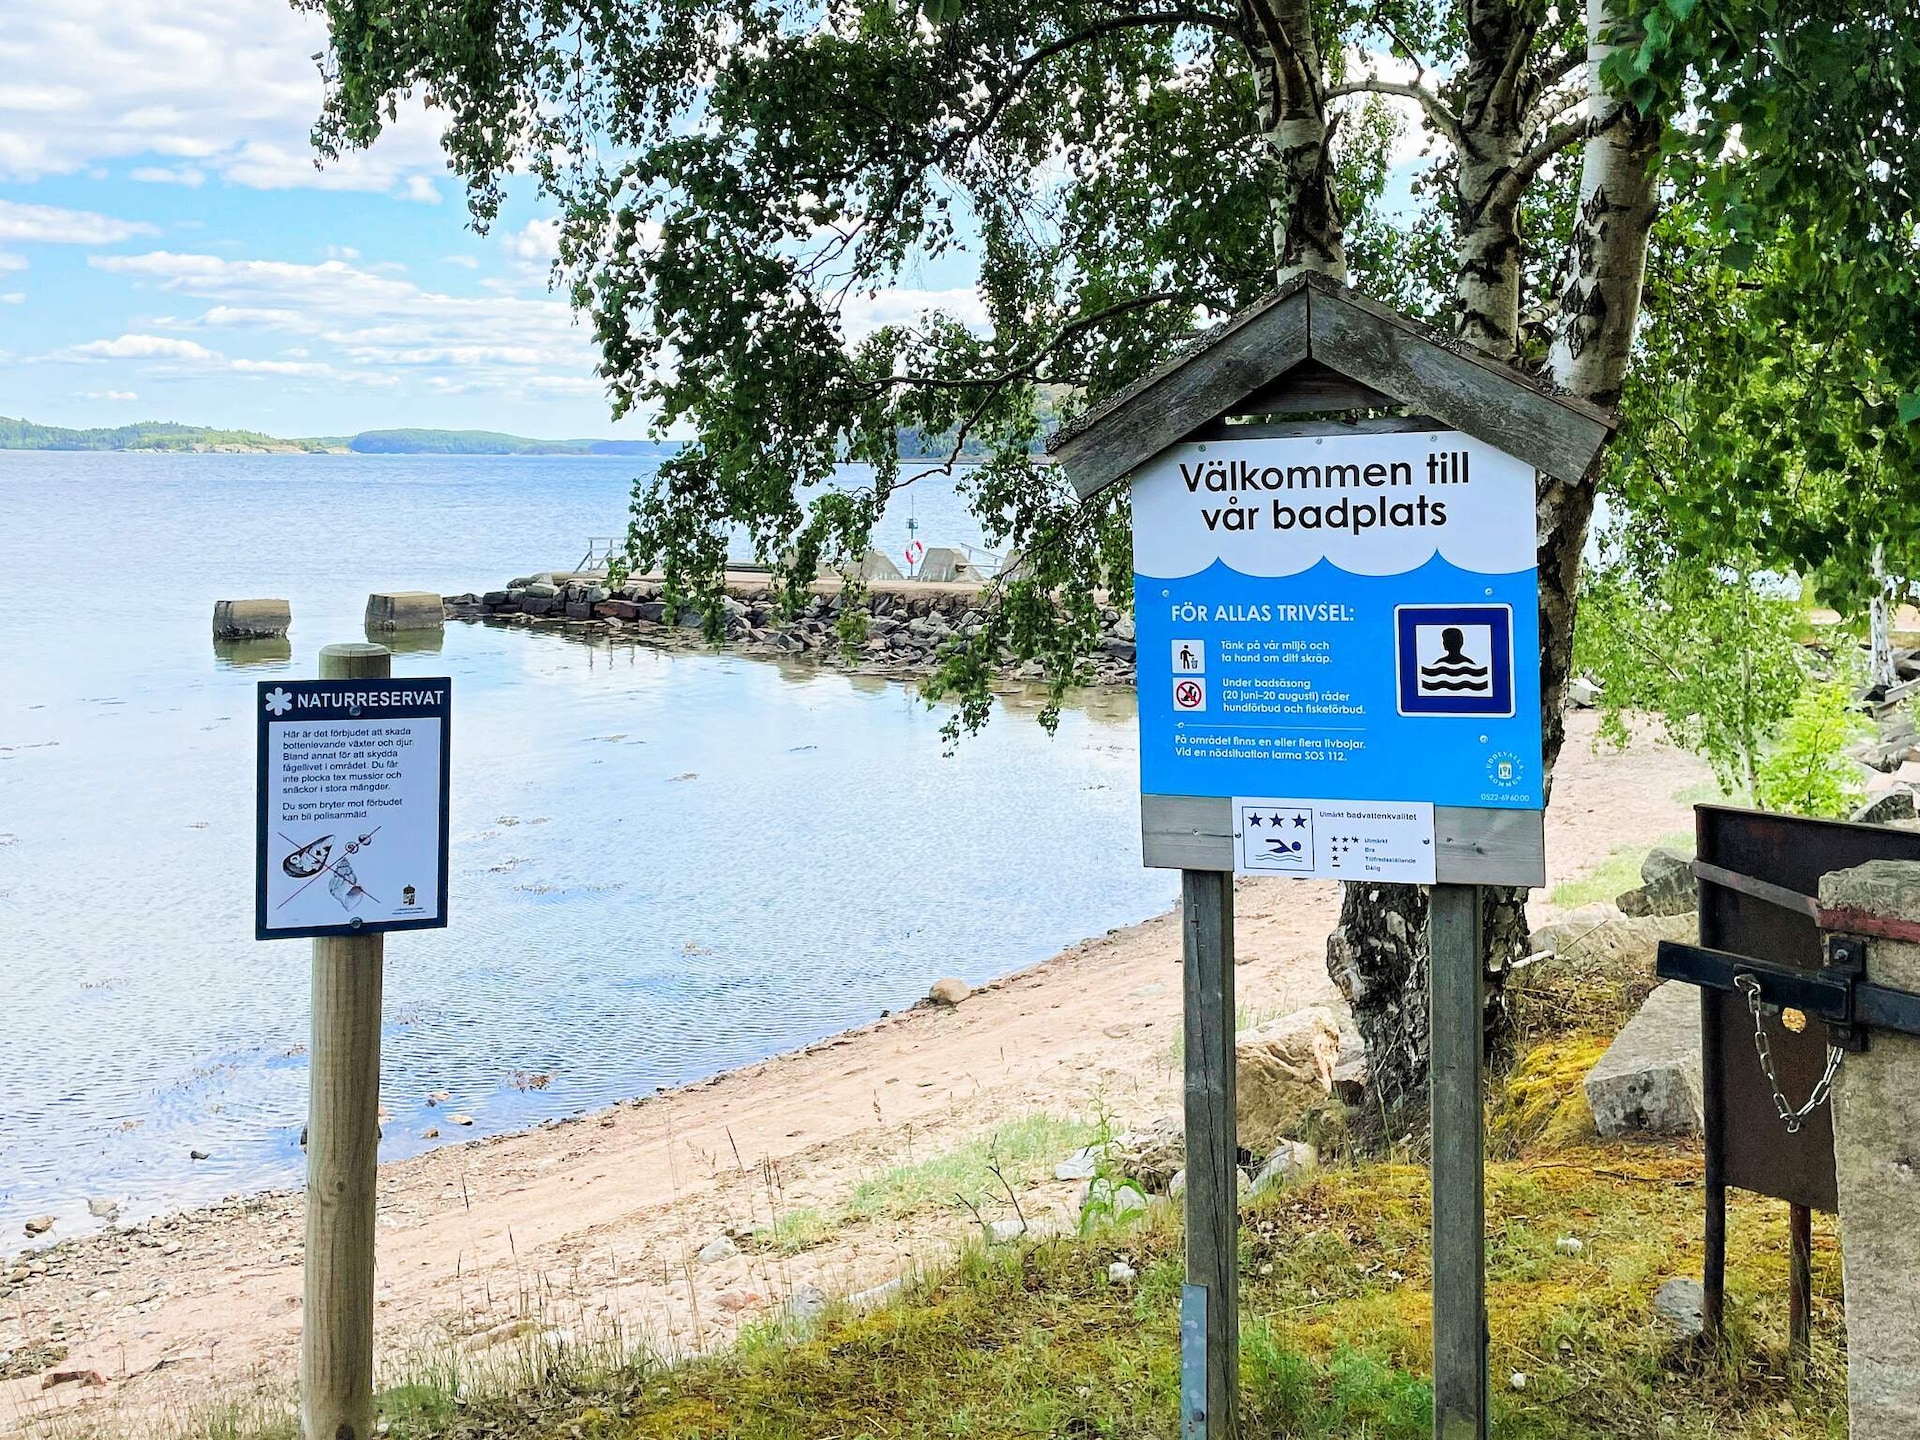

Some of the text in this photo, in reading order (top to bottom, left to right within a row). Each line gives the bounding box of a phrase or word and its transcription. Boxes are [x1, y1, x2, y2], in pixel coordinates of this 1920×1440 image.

[1179, 451, 1469, 492] Välkommen till
[1201, 495, 1447, 536] vår badplats
[1171, 601, 1355, 622] FÖR ALLAS TRIVSEL:
[1221, 640, 1330, 652] Tänk på vår miljö och
[1221, 653, 1332, 664] ta hand om ditt skräp.
[1222, 678, 1311, 690] Under badsäsong
[298, 690, 444, 708] NATURRESERVAT
[1222, 690, 1238, 701] (20
[1278, 691, 1319, 702] augusti)
[1321, 691, 1349, 701] råder
[1223, 703, 1366, 715] hundförbud och fiskeförbud.
[283, 728, 411, 739] Här är det förbjudet att skada
[283, 741, 346, 750] bottenlevande
[349, 739, 375, 748] växter
[377, 738, 394, 747] och
[1175, 733, 1366, 751] På området finns en eller flera livbojar.
[283, 752, 309, 760] Bland
[340, 751, 350, 759] för
[353, 751, 364, 759] att
[367, 750, 398, 760] skydda
[1175, 747, 1347, 761] Vid en nödsituation larma SOS 112.
[1486, 751, 1524, 769] UDDEVALLA
[283, 763, 322, 774] fågellivet
[371, 761, 384, 769] Du
[386, 760, 398, 768] får
[283, 775, 299, 783] inte
[301, 774, 330, 783] plocka
[349, 772, 383, 781] musslor
[385, 771, 402, 779] och
[1488, 774, 1521, 787] KOMMUN
[283, 785, 318, 794] snäckor
[325, 784, 347, 792] stora
[283, 798, 403, 810] Du som bryter mot förbudet
[282, 813, 298, 821] kan
[301, 812, 311, 821] bli
